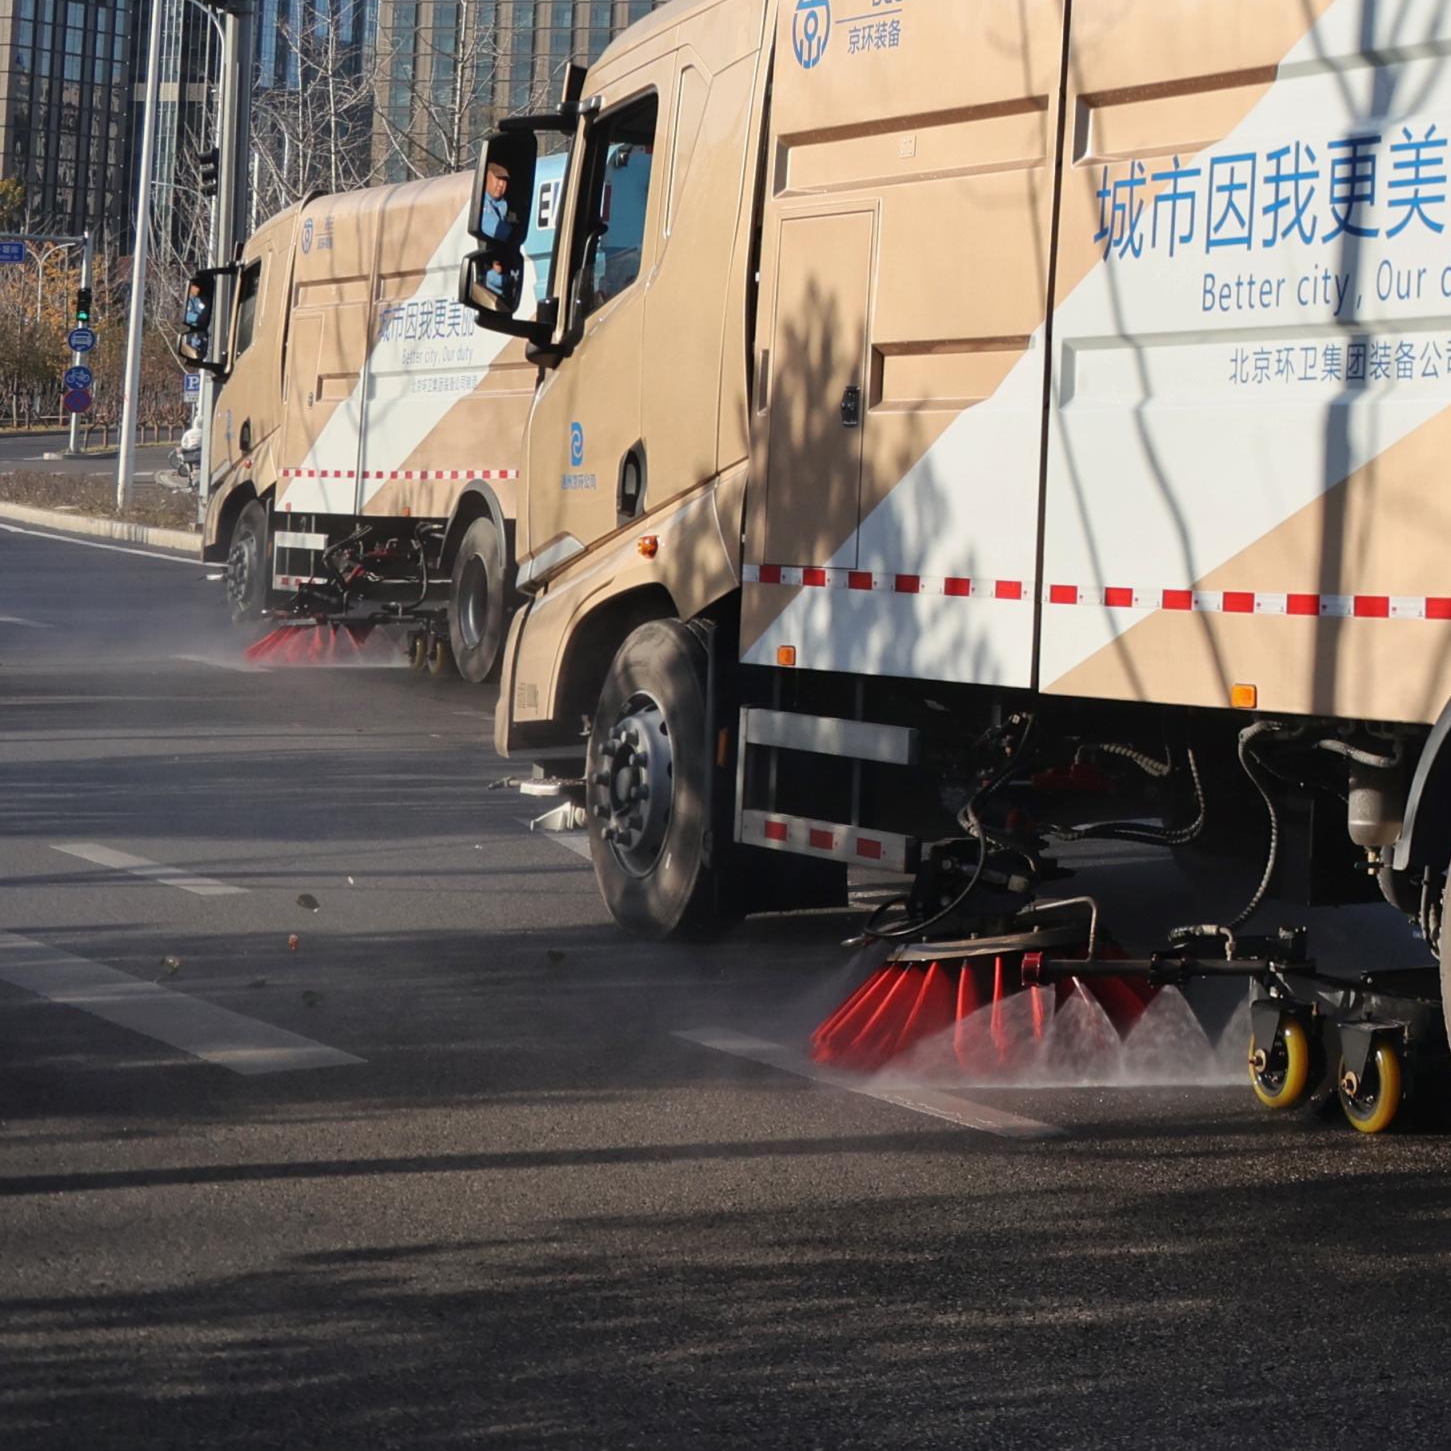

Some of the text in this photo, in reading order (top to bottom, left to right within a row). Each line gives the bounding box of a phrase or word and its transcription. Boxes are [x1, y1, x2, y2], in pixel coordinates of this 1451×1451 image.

[848, 19, 901, 54] 京环装备
[1202, 272, 1286, 313] Better
[1376, 258, 1427, 302] Our
[187, 376, 200, 390] P
